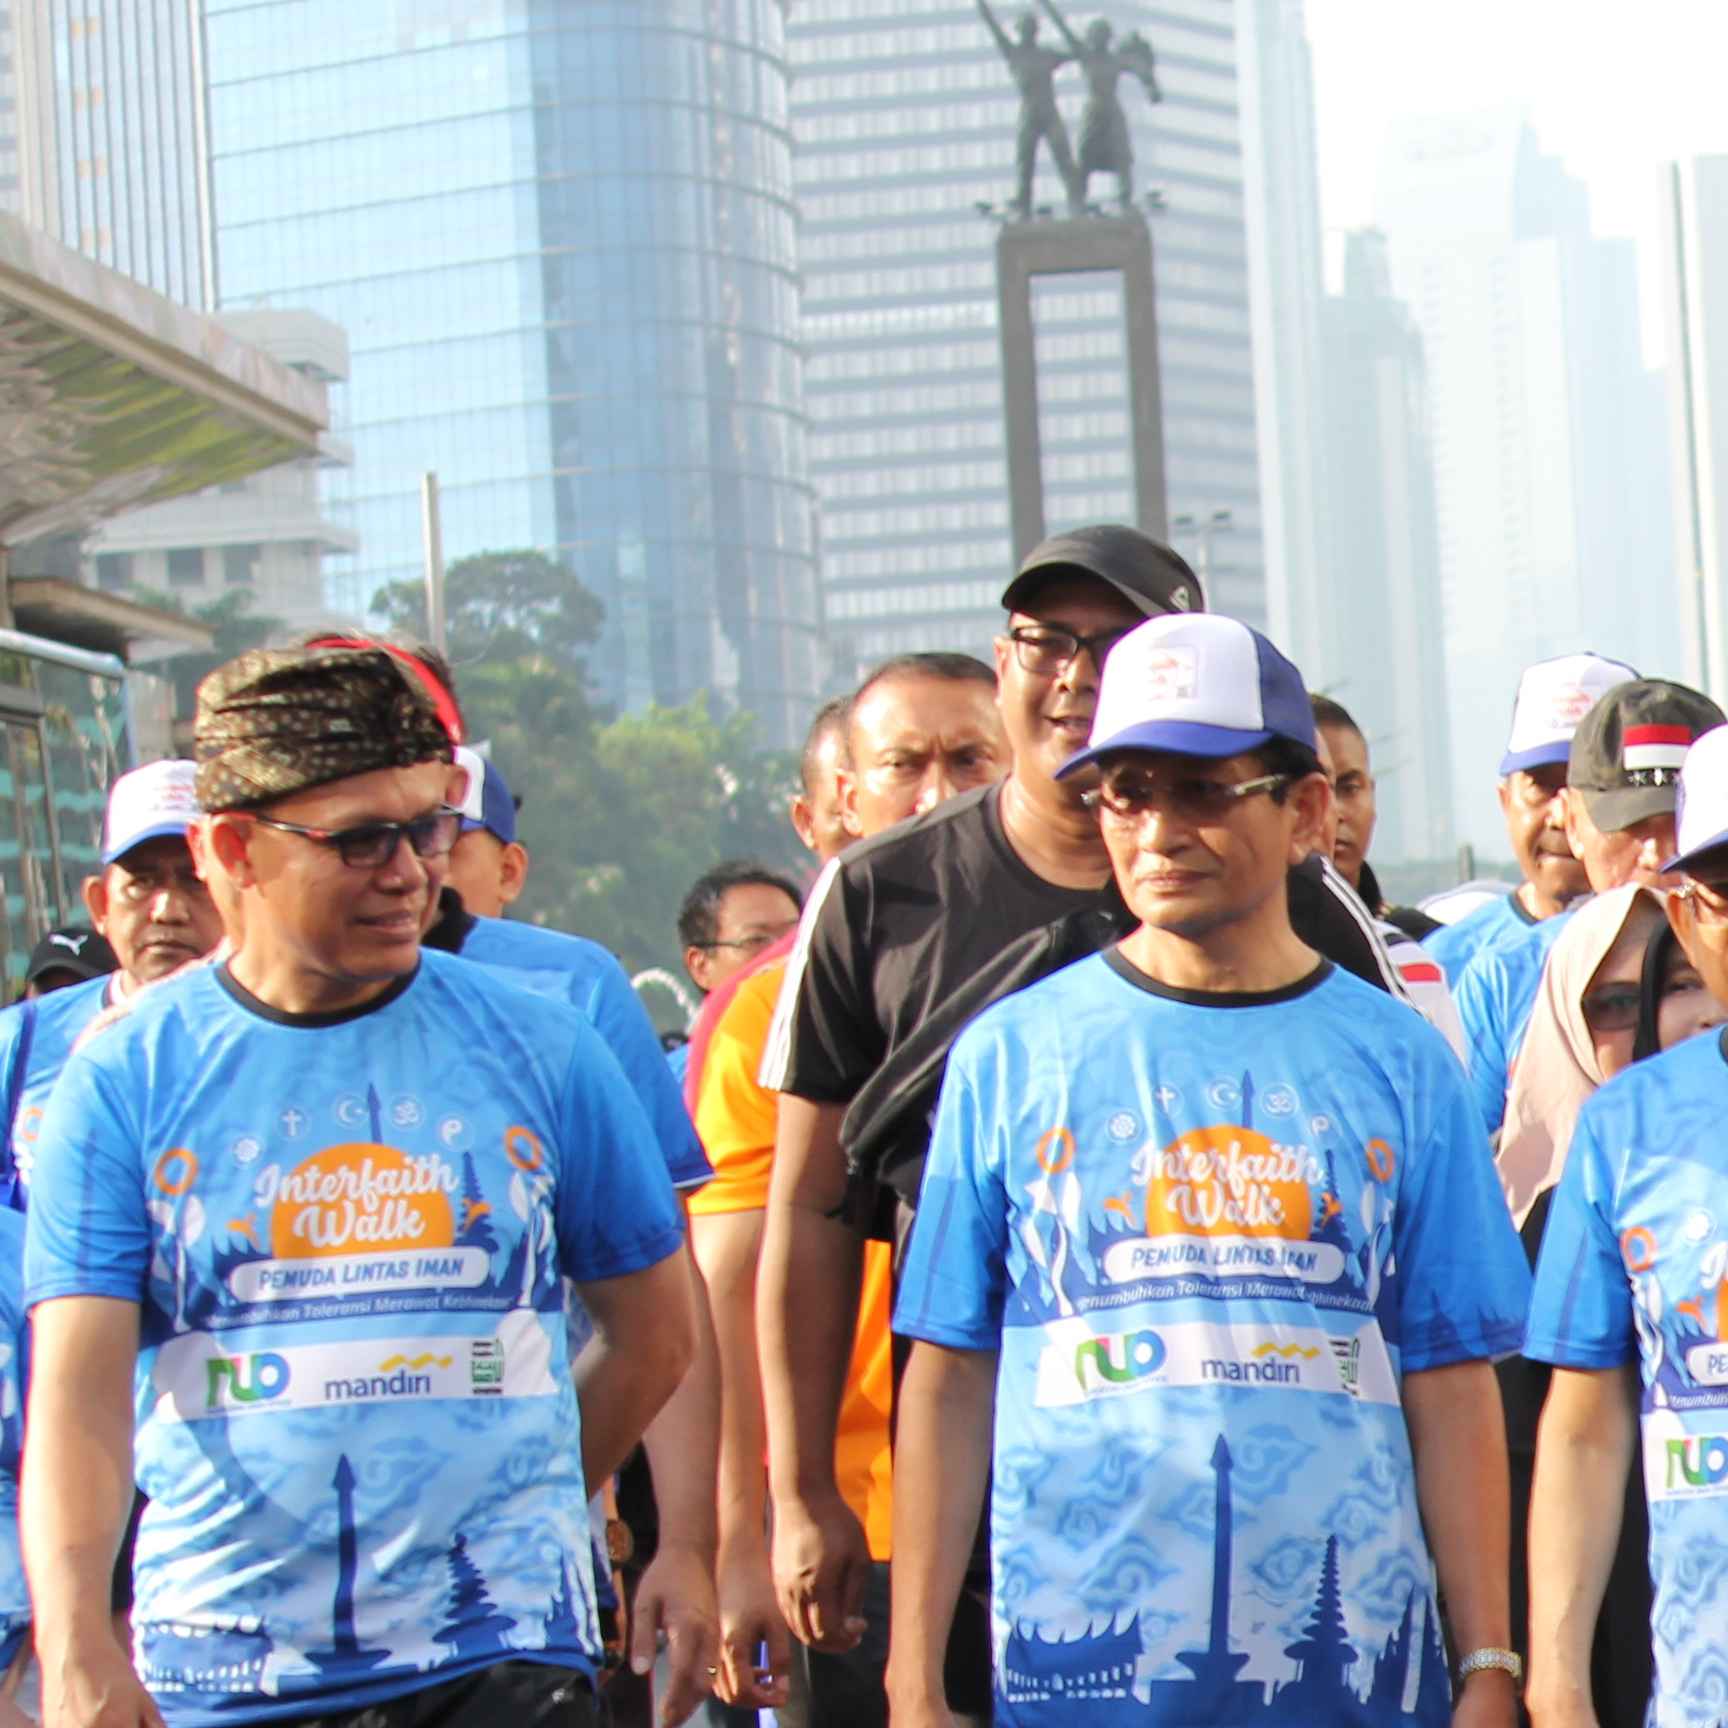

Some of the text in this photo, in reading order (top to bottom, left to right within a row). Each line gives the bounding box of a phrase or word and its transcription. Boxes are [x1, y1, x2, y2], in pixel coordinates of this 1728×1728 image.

[255, 1153, 460, 1211] Interfaith
[1131, 1140, 1326, 1199] Interfaith
[293, 1198, 426, 1248] Walk
[1165, 1183, 1287, 1229] Walk
[259, 1257, 464, 1289] PEMUDA LINTAS IMAN
[1132, 1246, 1207, 1268] PEMUDA
[324, 1370, 431, 1400] mandiri
